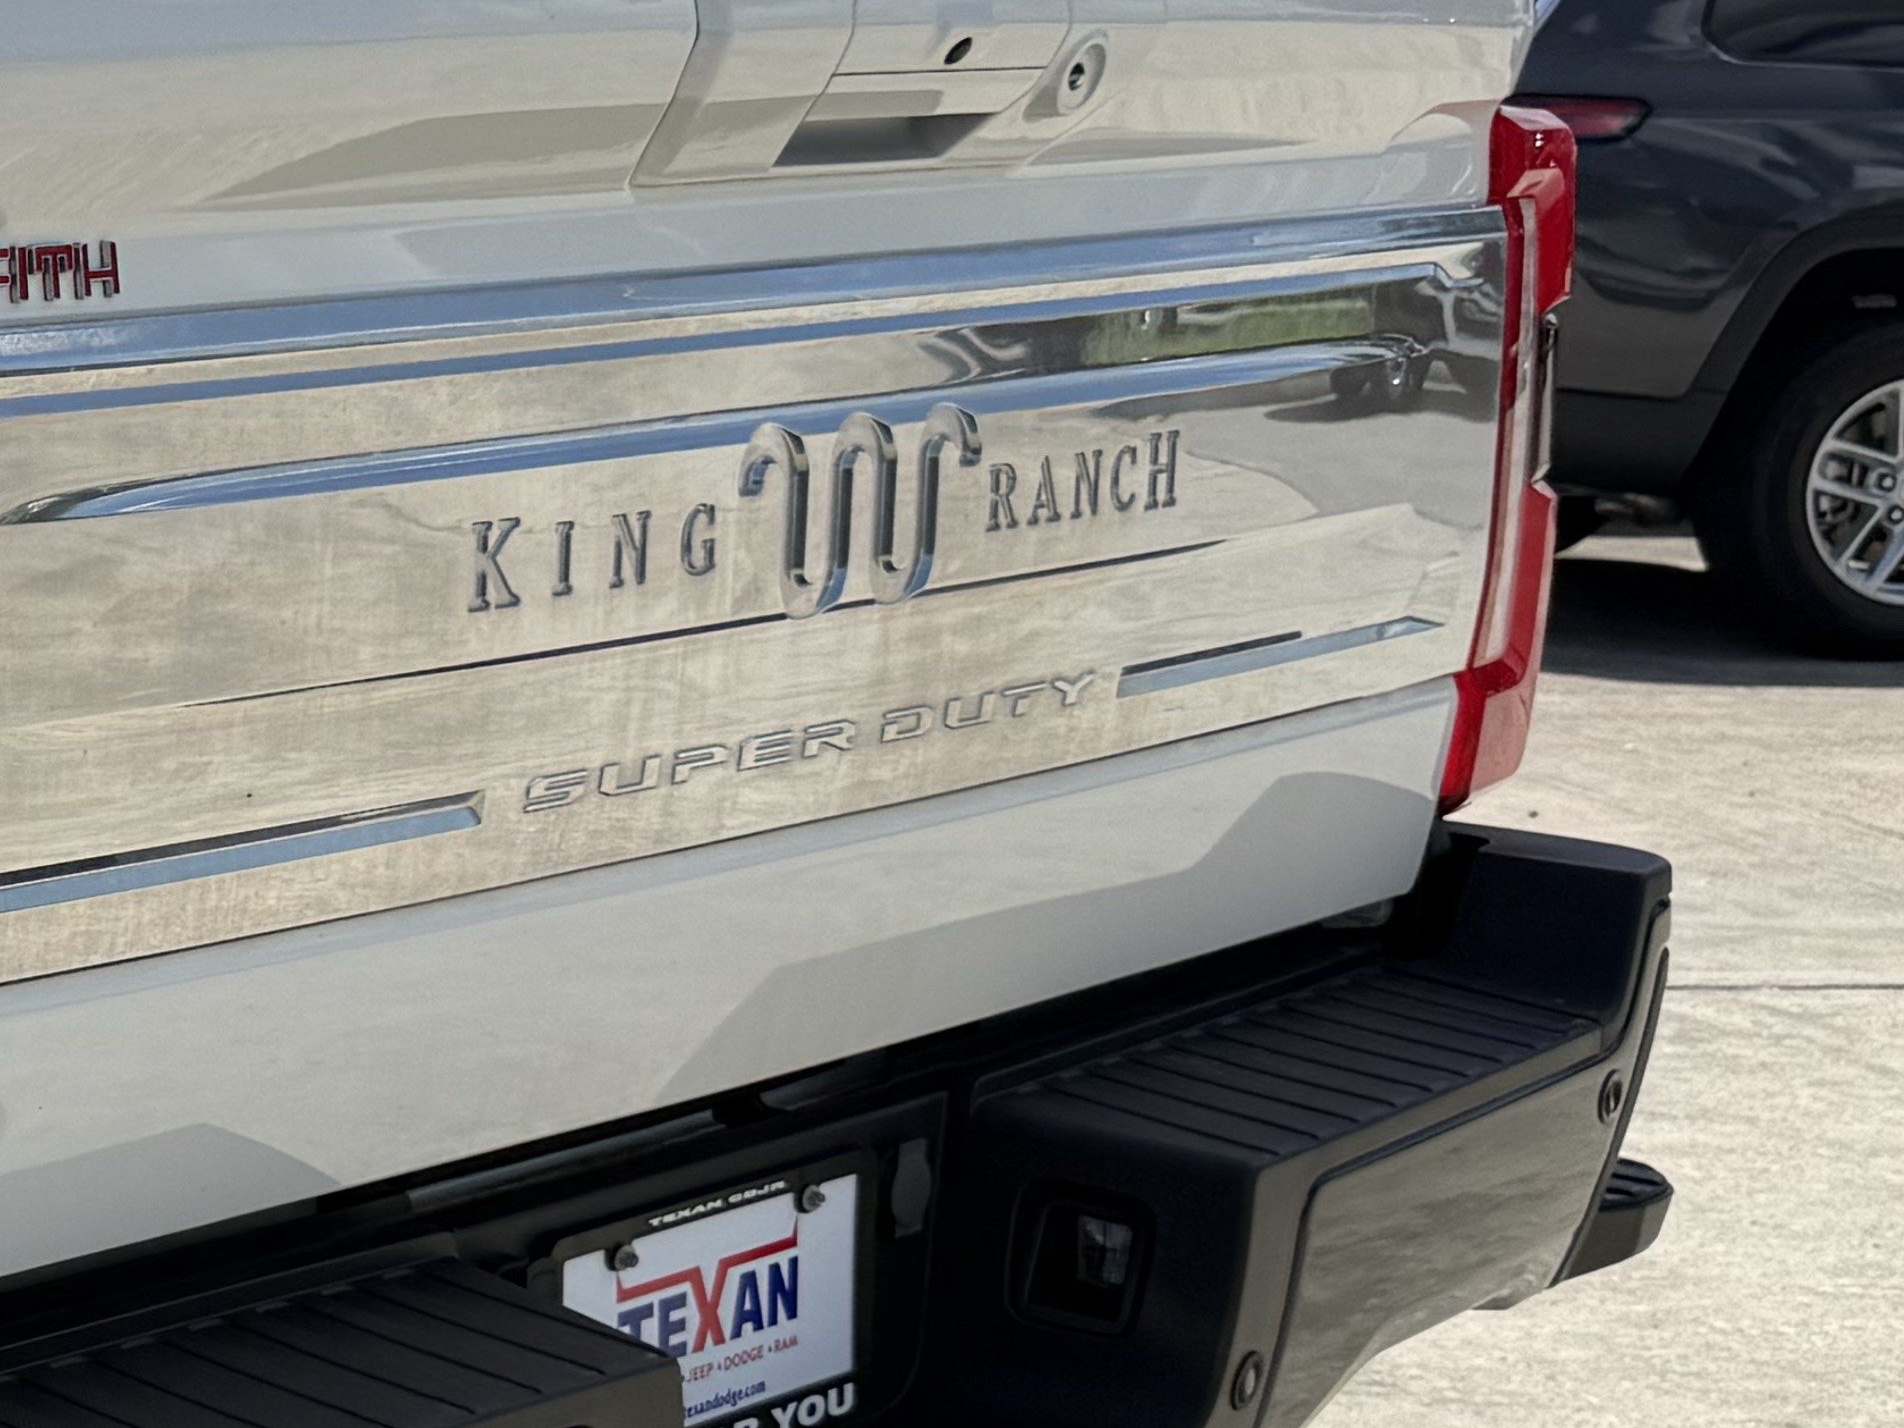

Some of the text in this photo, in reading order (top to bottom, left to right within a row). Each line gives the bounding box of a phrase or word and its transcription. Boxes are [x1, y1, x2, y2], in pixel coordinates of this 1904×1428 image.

[466, 428, 1182, 614] KING RANCH
[522, 669, 1100, 814] SUPER DUTY
[648, 1198, 723, 1228] TEXAN
[617, 1227, 799, 1359] TEXAN
[723, 1345, 765, 1372] DODGE
[773, 1335, 799, 1355] RAM
[685, 1380, 767, 1418] exandodge.com
